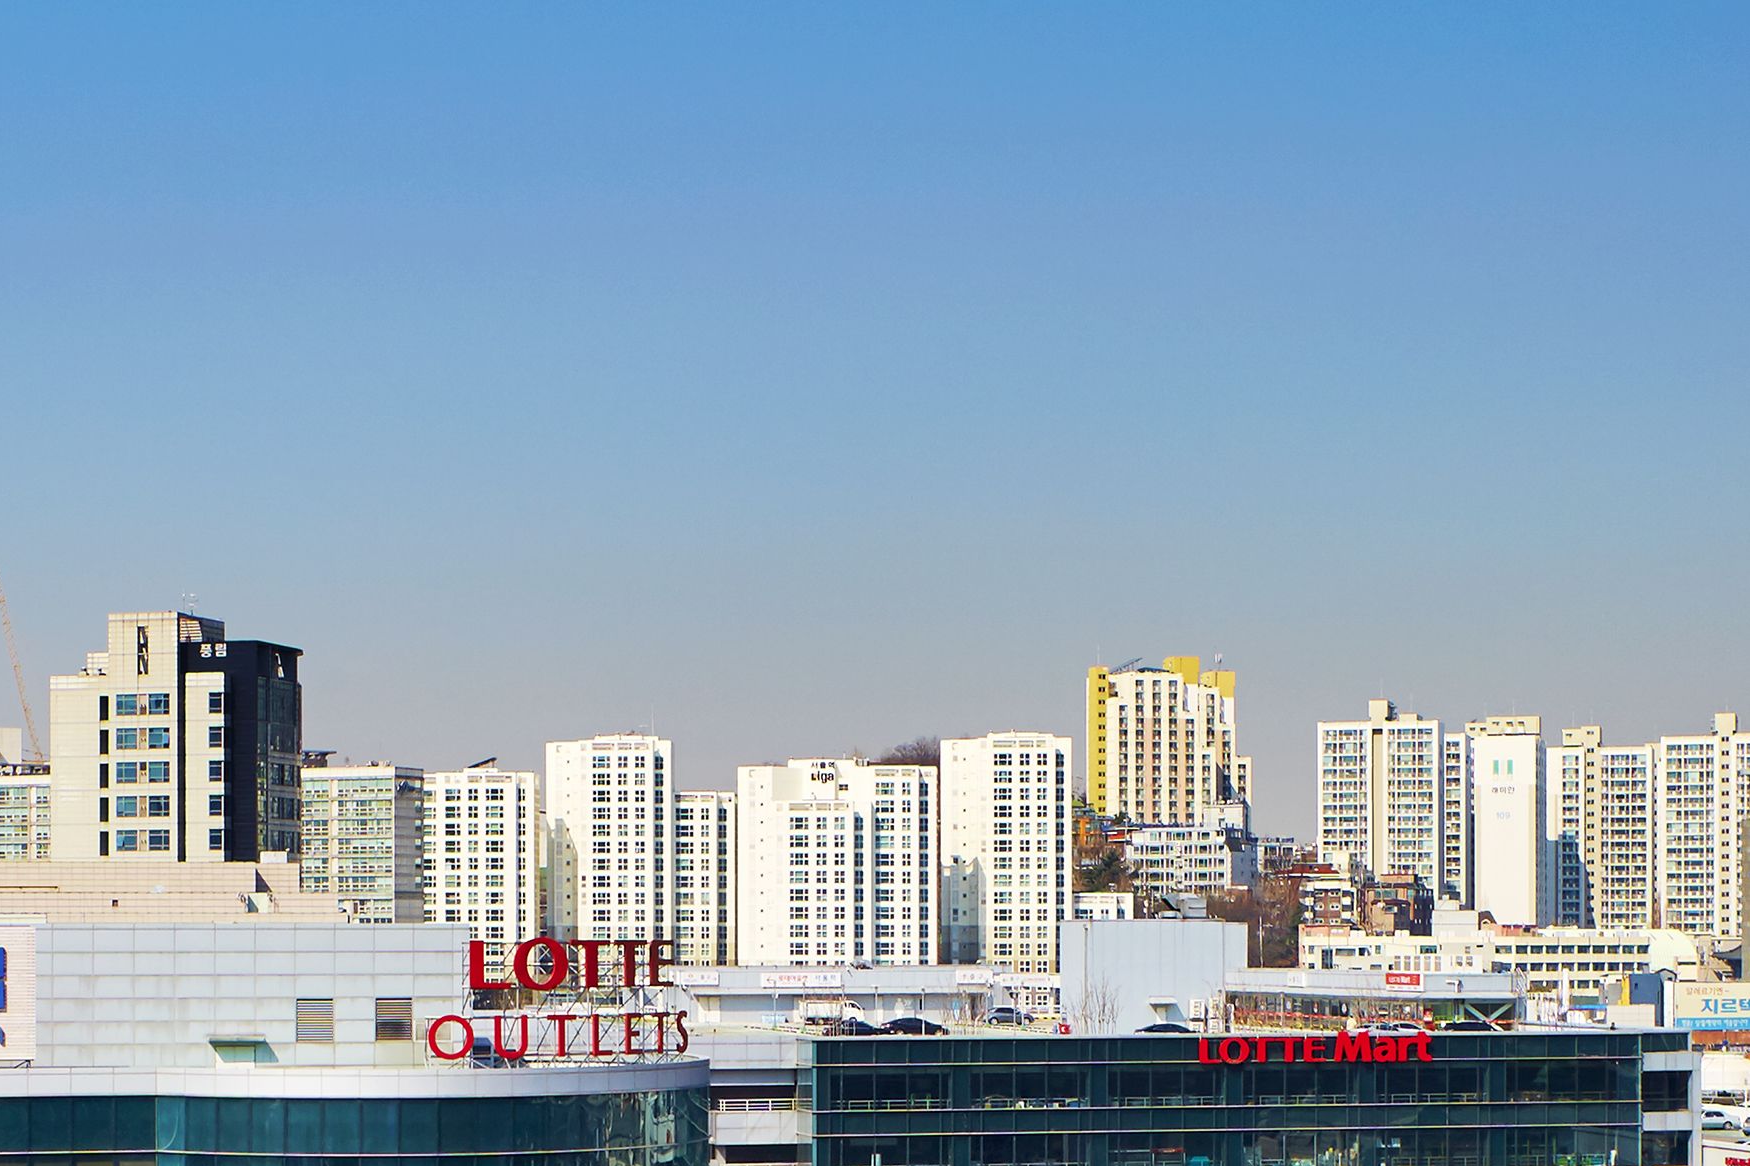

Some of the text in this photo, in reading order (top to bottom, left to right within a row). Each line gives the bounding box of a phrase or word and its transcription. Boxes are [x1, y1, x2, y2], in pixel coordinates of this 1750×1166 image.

[199, 643, 227, 658] 풍림
[1491, 785, 1515, 795] 래미안
[469, 937, 674, 991] LOTTE
[428, 1010, 689, 1060] OUTLETS
[1199, 1031, 1433, 1065] LOTTE Mart
